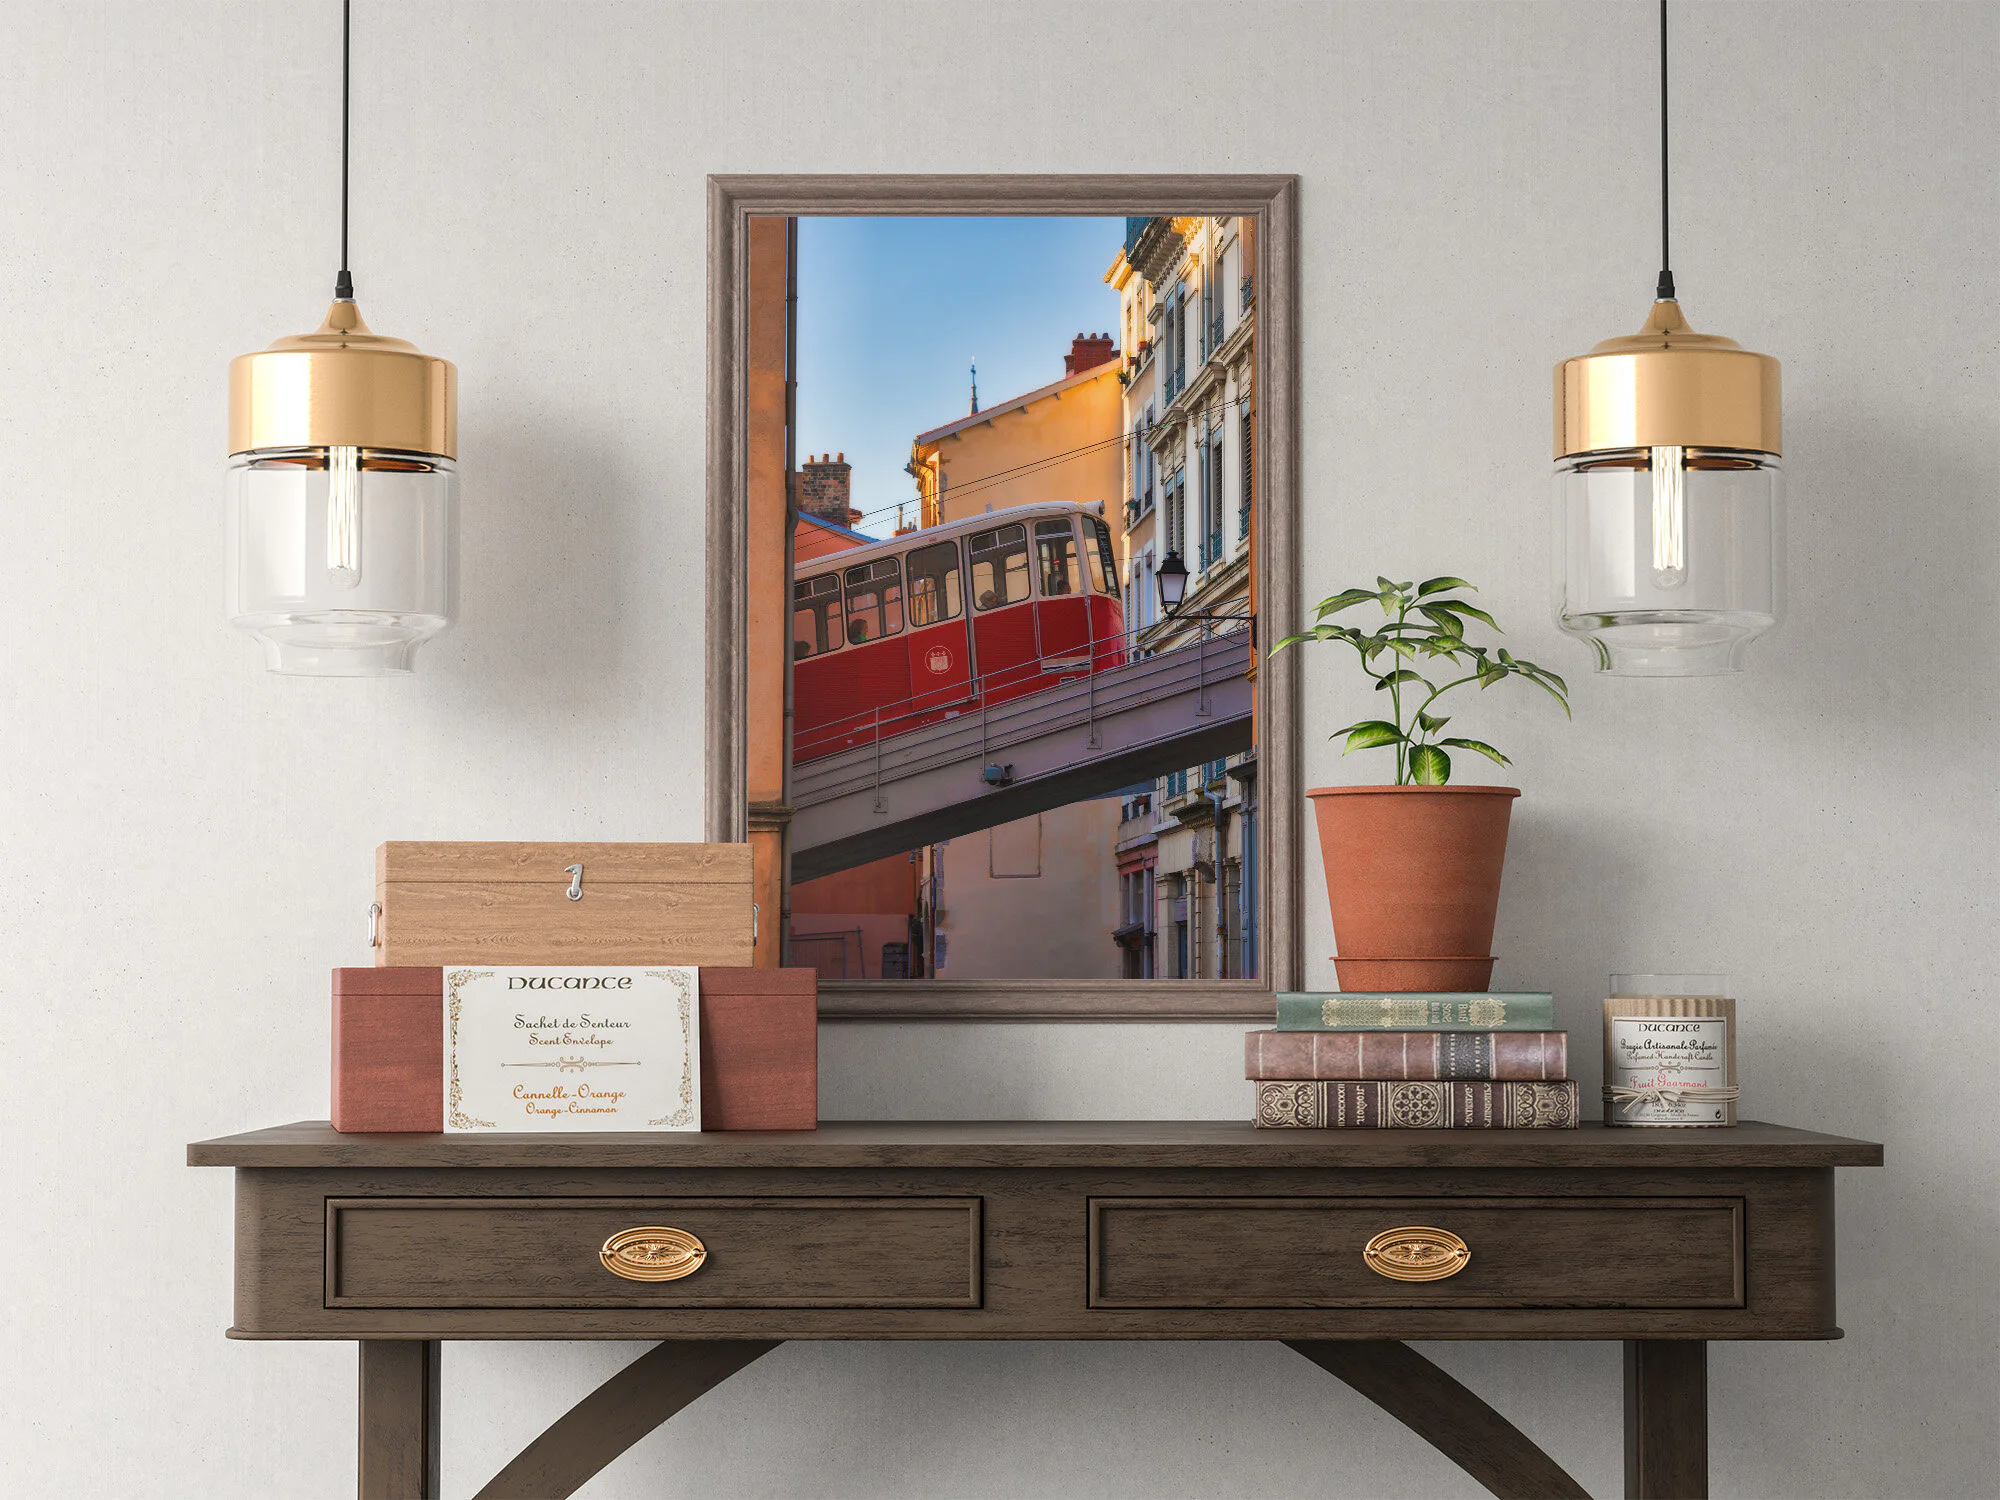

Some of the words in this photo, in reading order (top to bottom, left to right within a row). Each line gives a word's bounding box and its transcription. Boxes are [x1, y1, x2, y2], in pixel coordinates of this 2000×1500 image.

[513, 1013, 560, 1029] Sachet
[562, 1017, 577, 1029] de
[579, 1013, 631, 1029] Senteur
[528, 1033, 562, 1046] Scent
[562, 1032, 615, 1048] Envelope
[1643, 1038, 1688, 1050] Artisanale
[1629, 1076, 1655, 1089] Fruit
[1657, 1074, 1707, 1088] Gourmand
